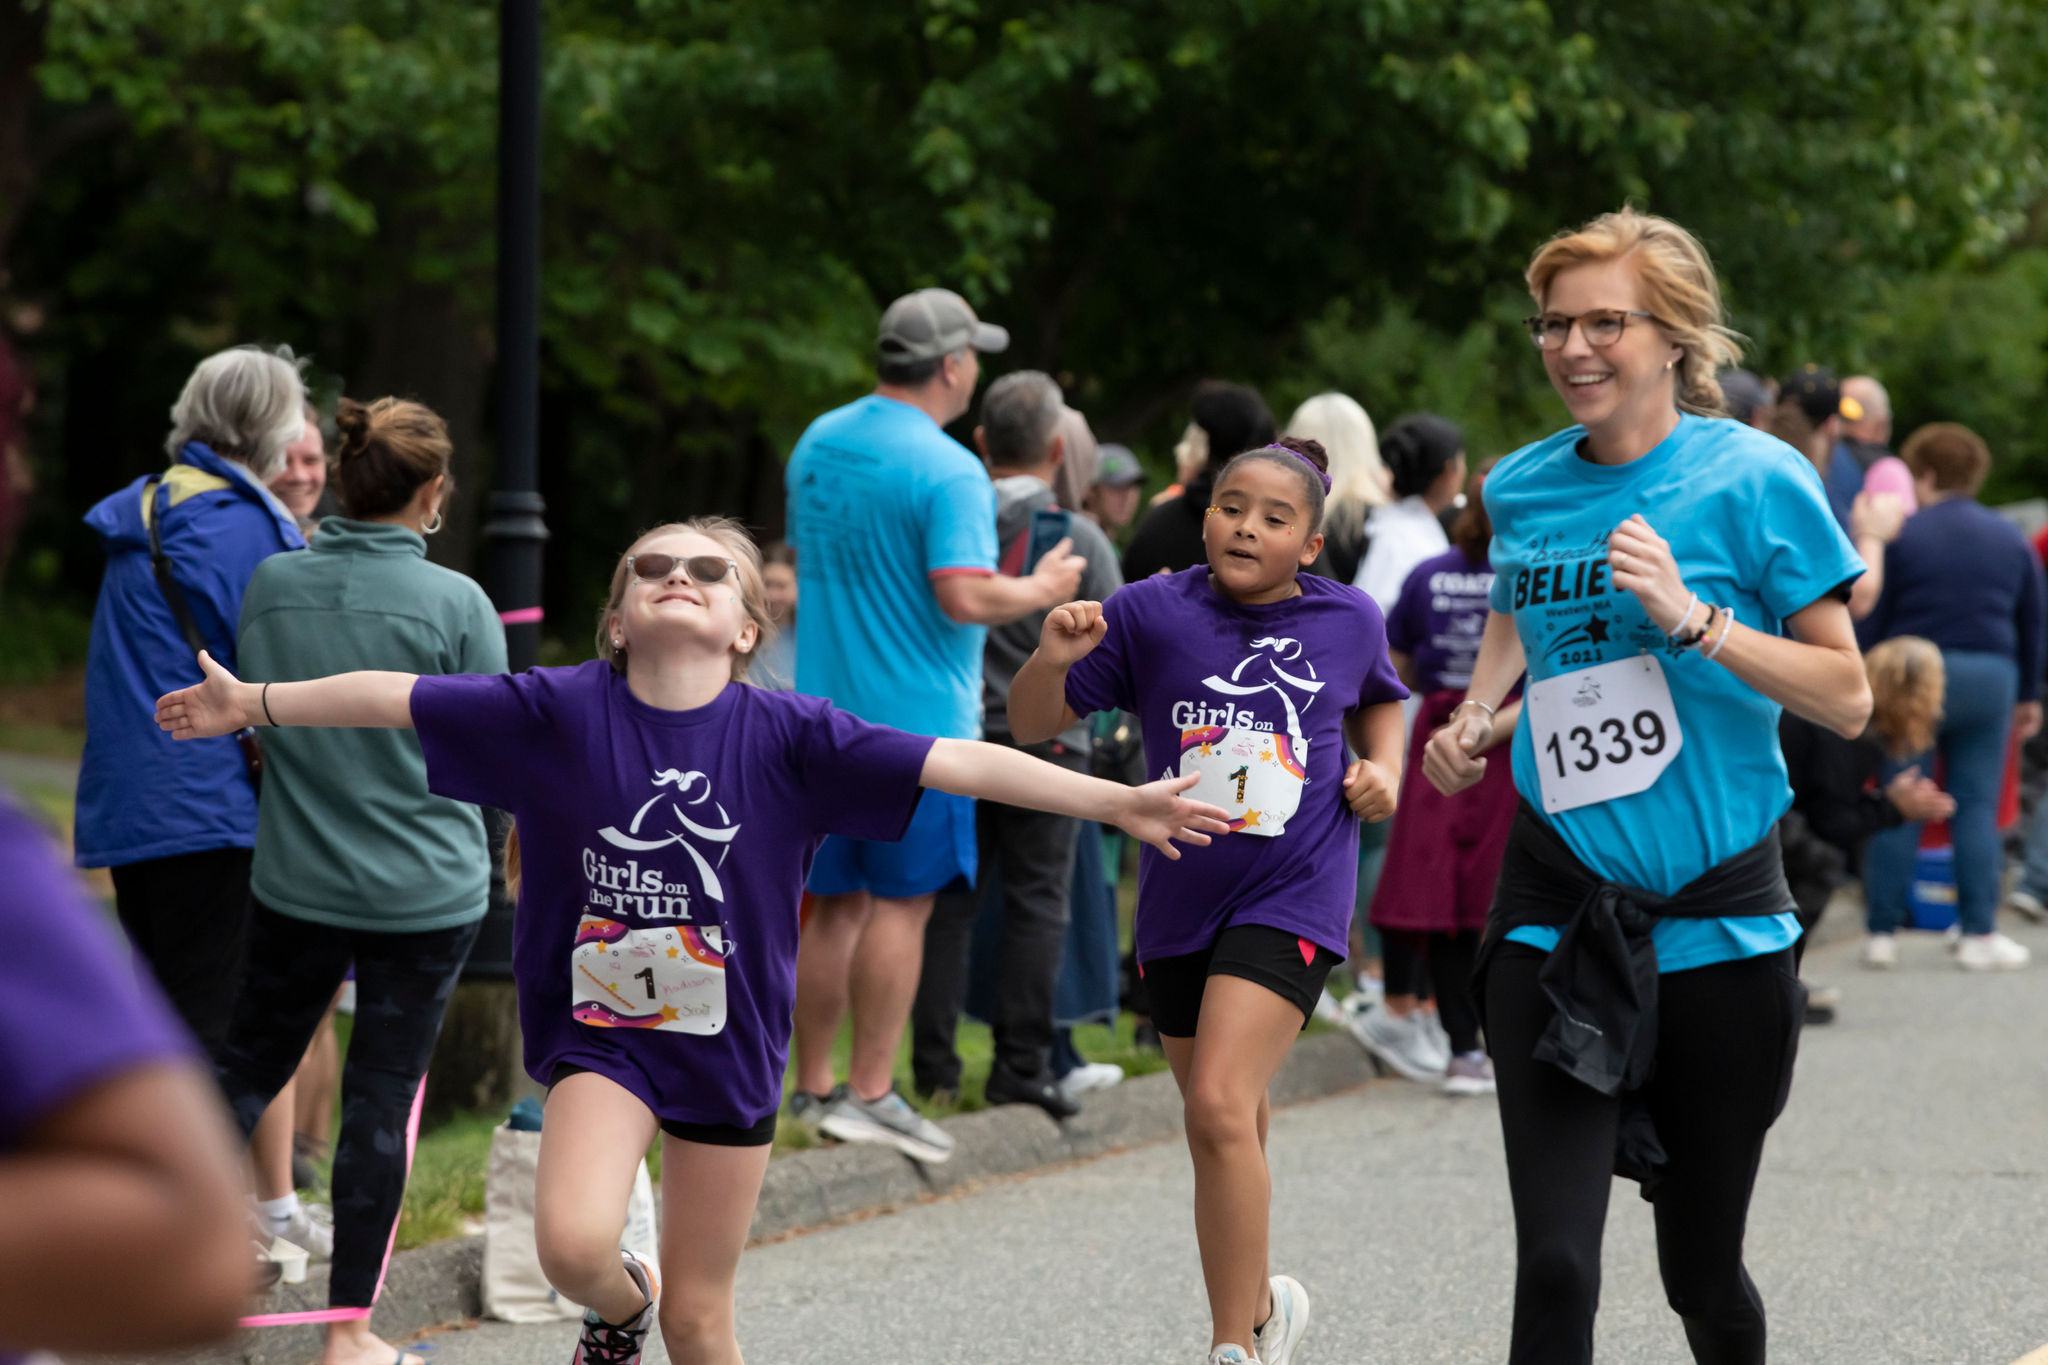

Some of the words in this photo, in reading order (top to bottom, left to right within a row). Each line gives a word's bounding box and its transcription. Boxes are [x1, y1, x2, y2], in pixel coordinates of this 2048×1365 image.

[1515, 558, 1624, 610] BELIE
[1171, 701, 1254, 730] Girls
[1255, 720, 1274, 731] on
[1546, 710, 1666, 778] 1339
[1229, 766, 1247, 803] 1
[582, 847, 664, 894] Girls
[664, 880, 689, 895] on
[590, 888, 613, 908] the
[612, 892, 693, 920] run
[634, 967, 656, 999] 1
